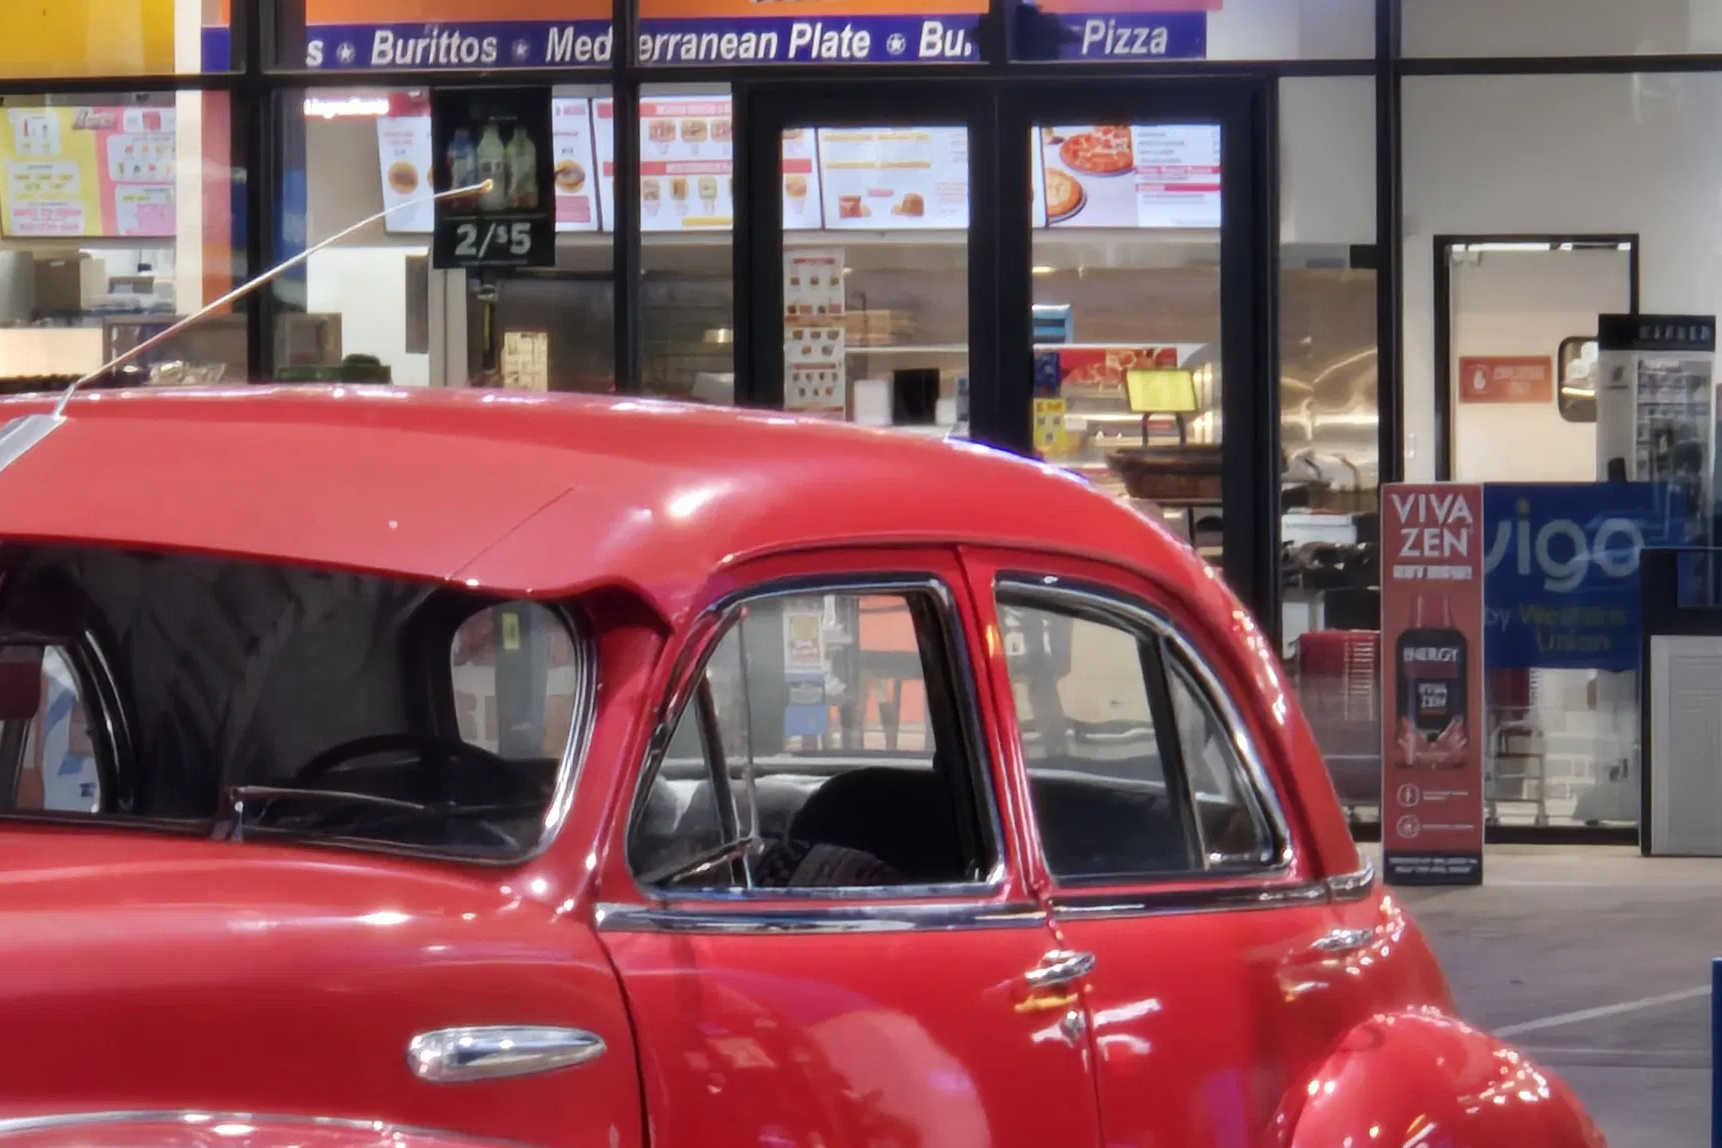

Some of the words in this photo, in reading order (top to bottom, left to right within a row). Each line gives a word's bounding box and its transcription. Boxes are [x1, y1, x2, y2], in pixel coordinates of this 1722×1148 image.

[371, 30, 498, 65] Burittos
[545, 23, 778, 63] Mederranean
[787, 22, 872, 60] Plate
[1081, 18, 1168, 55] Pizza
[455, 221, 532, 258] 2/$5
[1392, 493, 1473, 524] VIVA
[1399, 528, 1468, 557] ZEN
